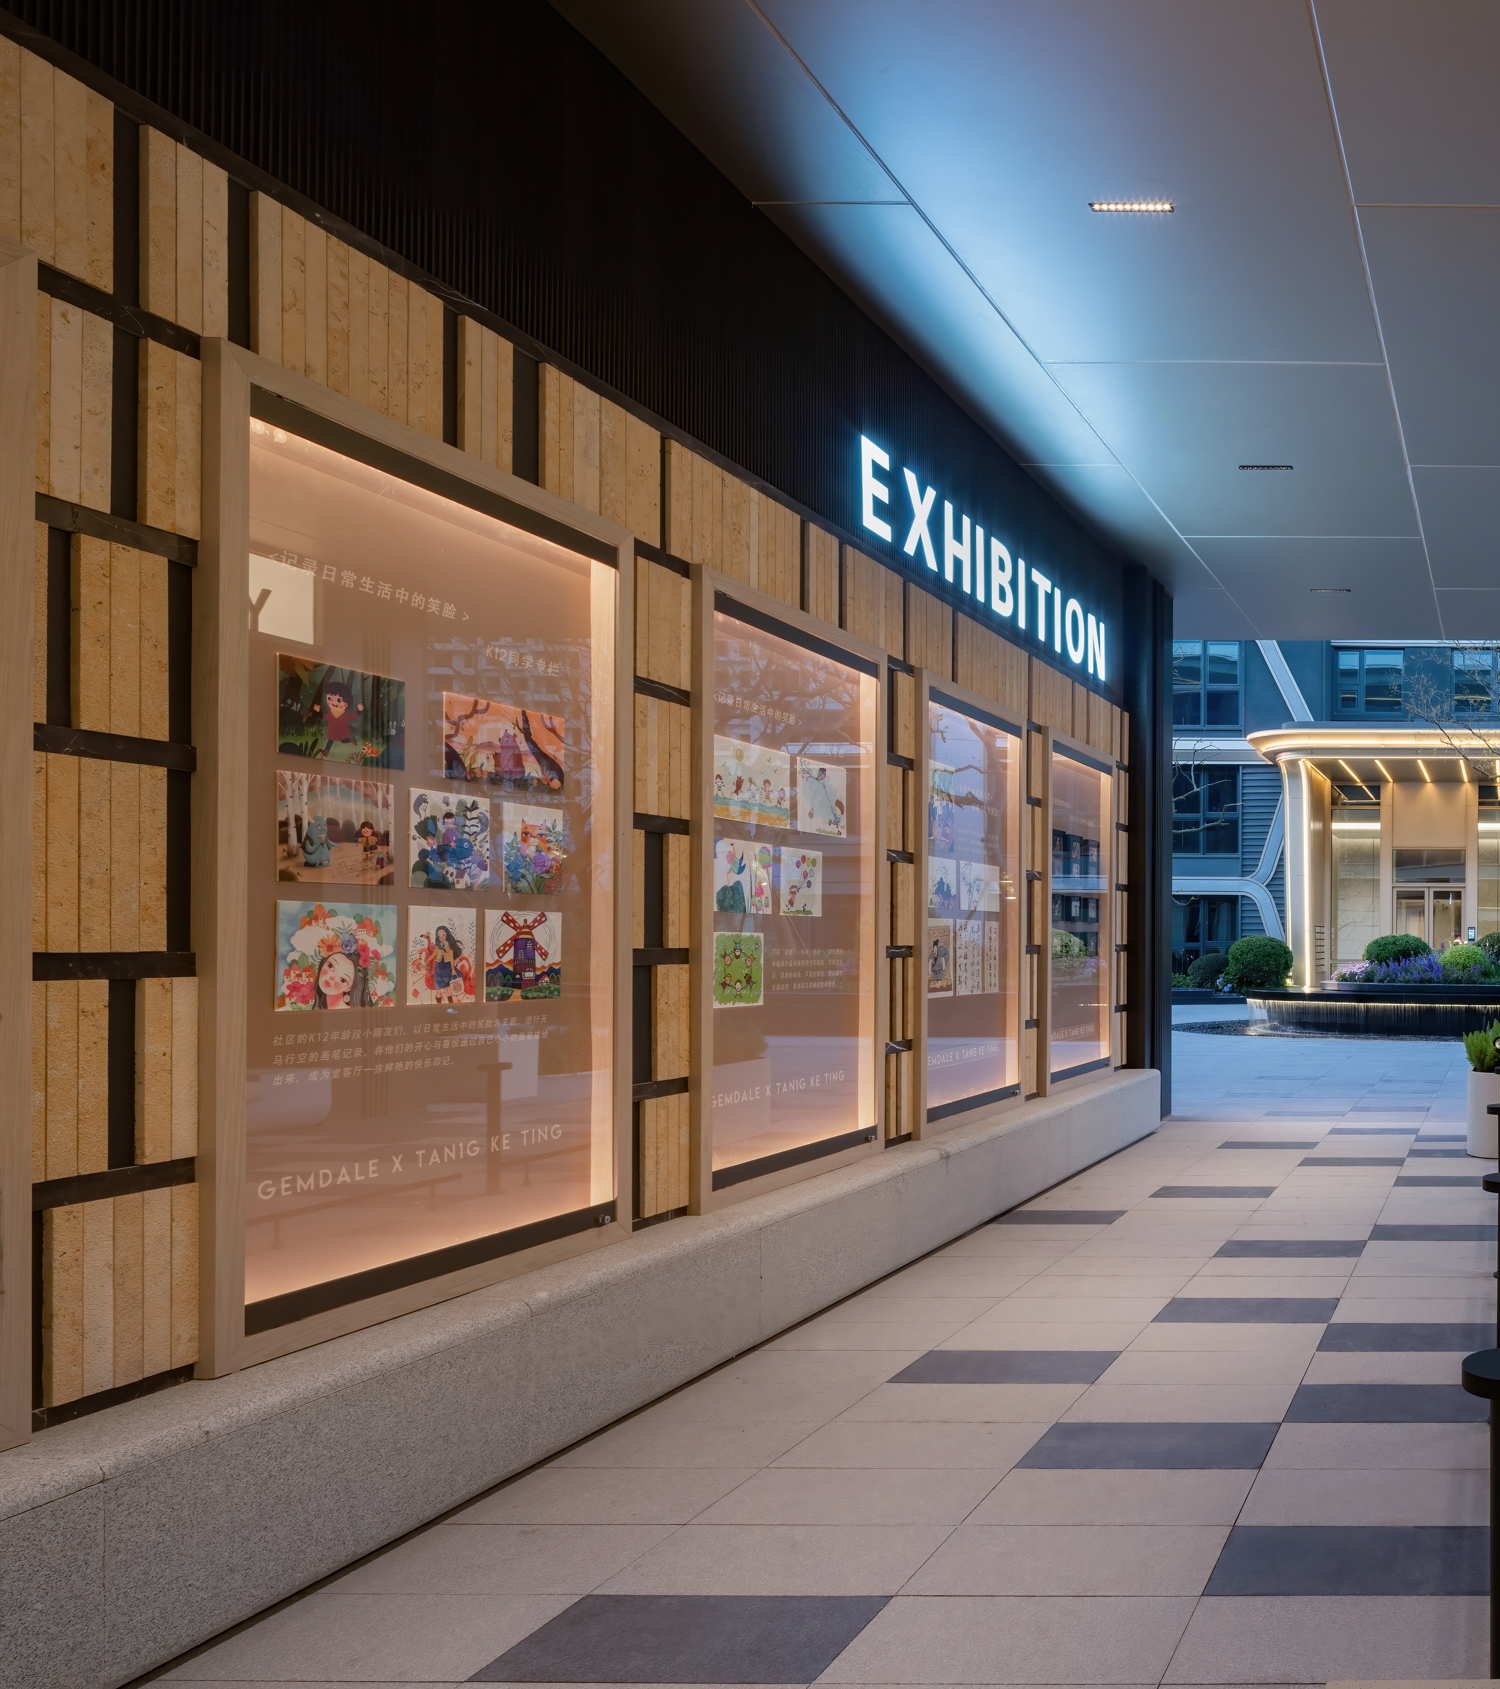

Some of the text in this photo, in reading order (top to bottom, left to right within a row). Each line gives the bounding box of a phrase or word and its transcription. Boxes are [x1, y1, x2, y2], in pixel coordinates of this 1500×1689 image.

[861, 434, 1106, 681] EXHIBITION
[485, 644, 559, 678] K12同学专栏
[927, 1051, 953, 1066] EMDALE
[765, 1084, 771, 1097] X
[810, 1074, 821, 1088] KE
[824, 1070, 845, 1084] TING
[257, 1158, 379, 1200] GEMDALE
[391, 1153, 403, 1174] X
[490, 1133, 511, 1153] KE
[520, 1124, 563, 1146] TING
